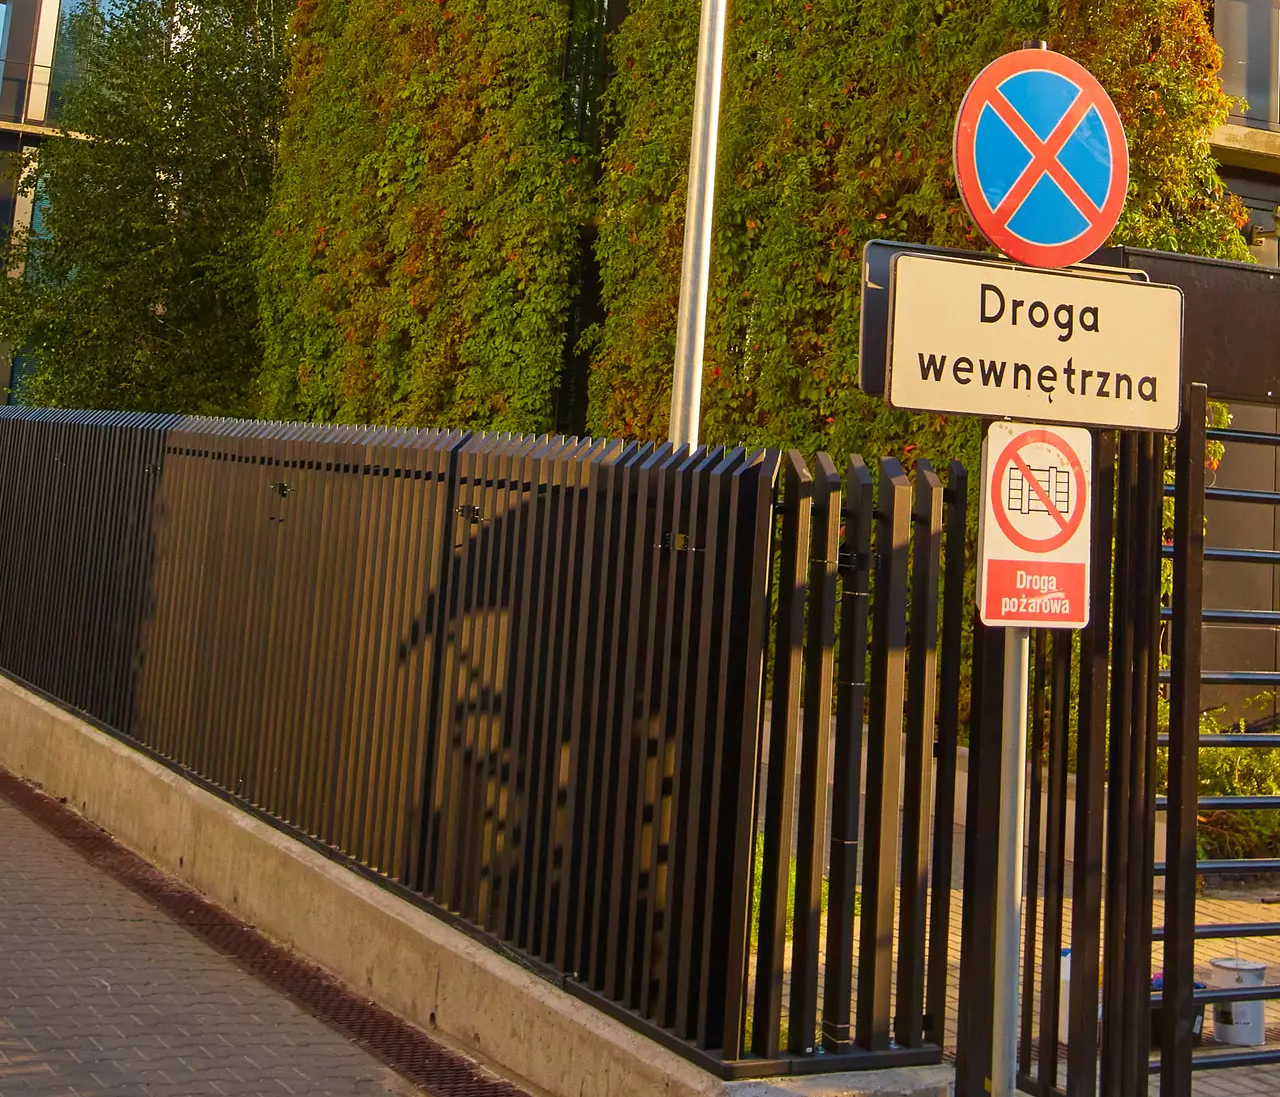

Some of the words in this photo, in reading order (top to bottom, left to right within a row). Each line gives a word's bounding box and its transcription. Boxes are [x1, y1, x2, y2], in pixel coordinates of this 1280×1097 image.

[980, 283, 1099, 342] Droga
[918, 352, 1158, 404] wewnętrzna
[1016, 570, 1057, 594] Droga
[1001, 594, 1070, 616] pożarowa
